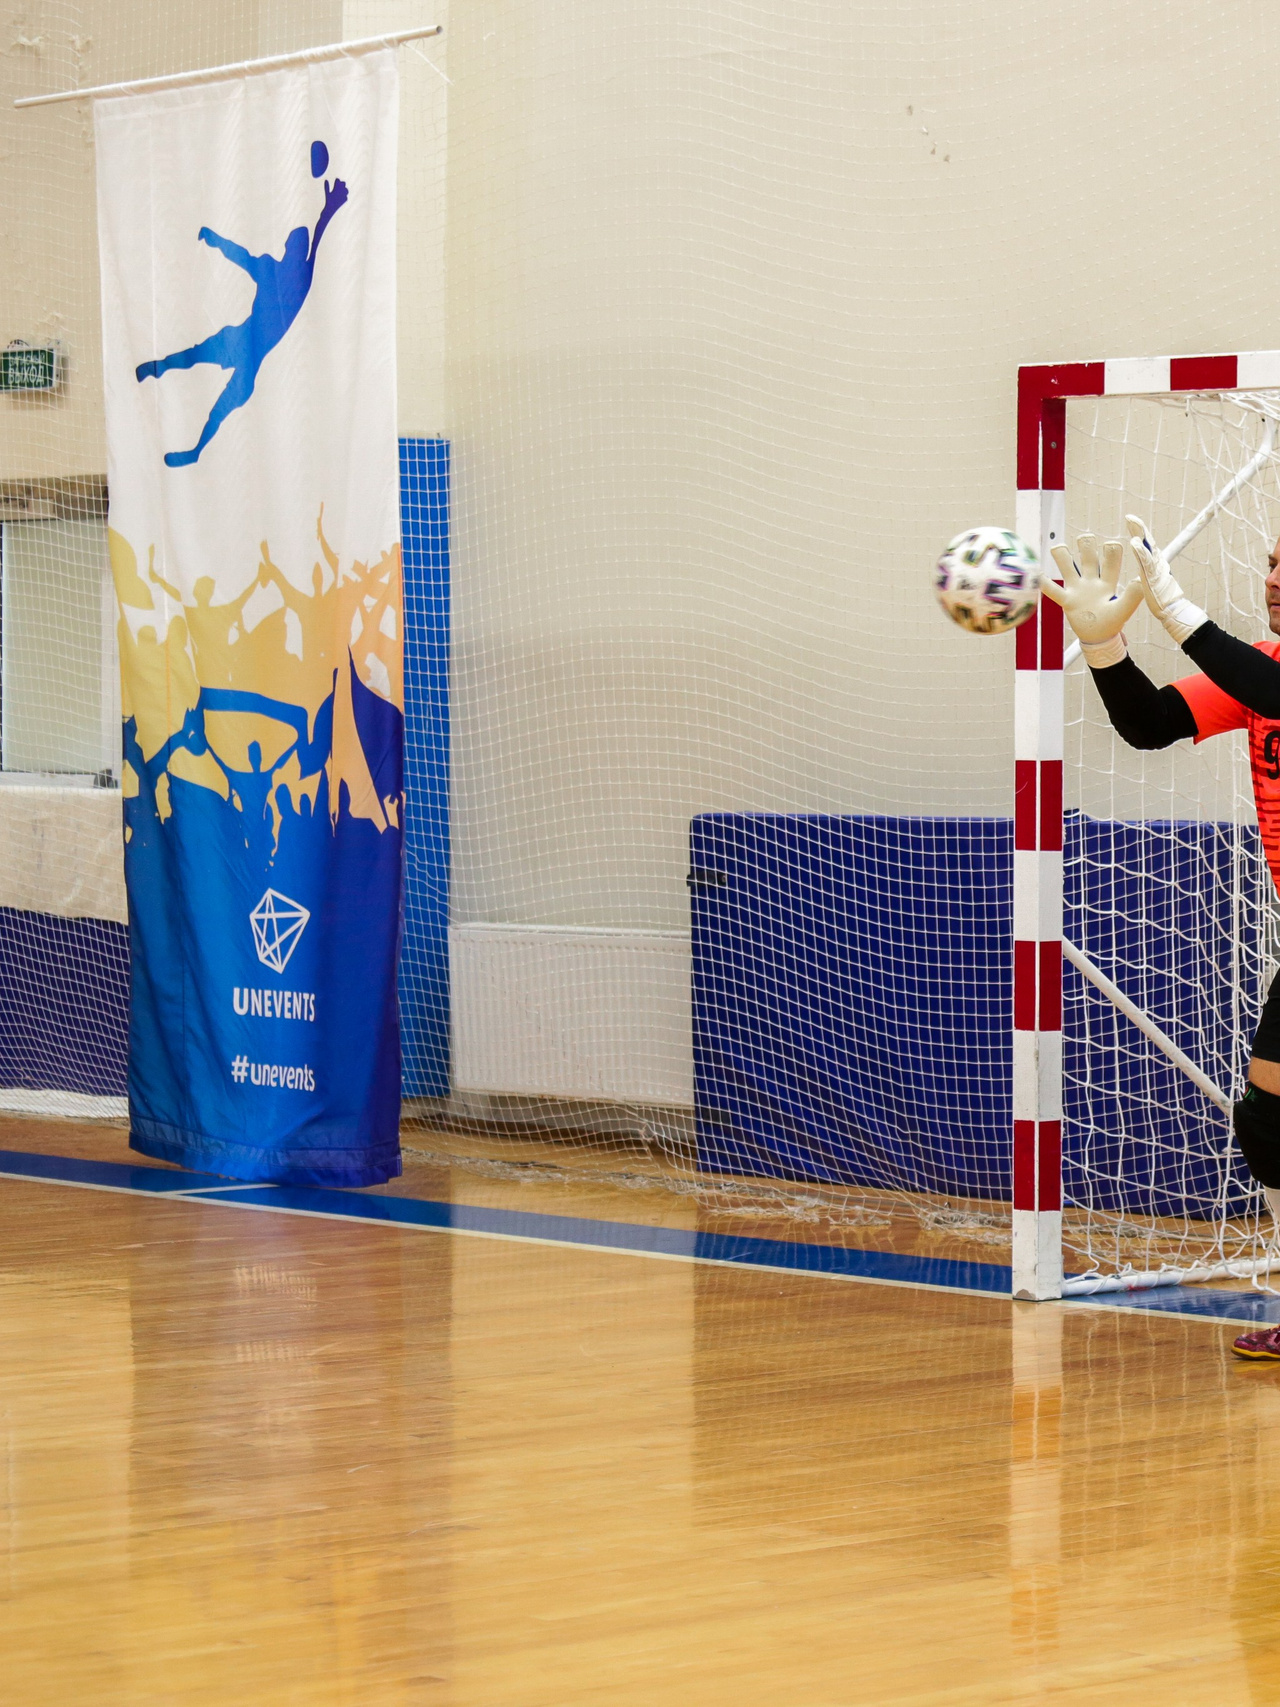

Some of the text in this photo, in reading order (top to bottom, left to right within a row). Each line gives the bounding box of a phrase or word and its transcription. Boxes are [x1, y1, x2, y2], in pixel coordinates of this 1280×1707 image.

[8, 365, 45, 386] ВЫХОД
[233, 987, 315, 1022] UNEVENTS
[231, 1055, 315, 1092] #unevents
